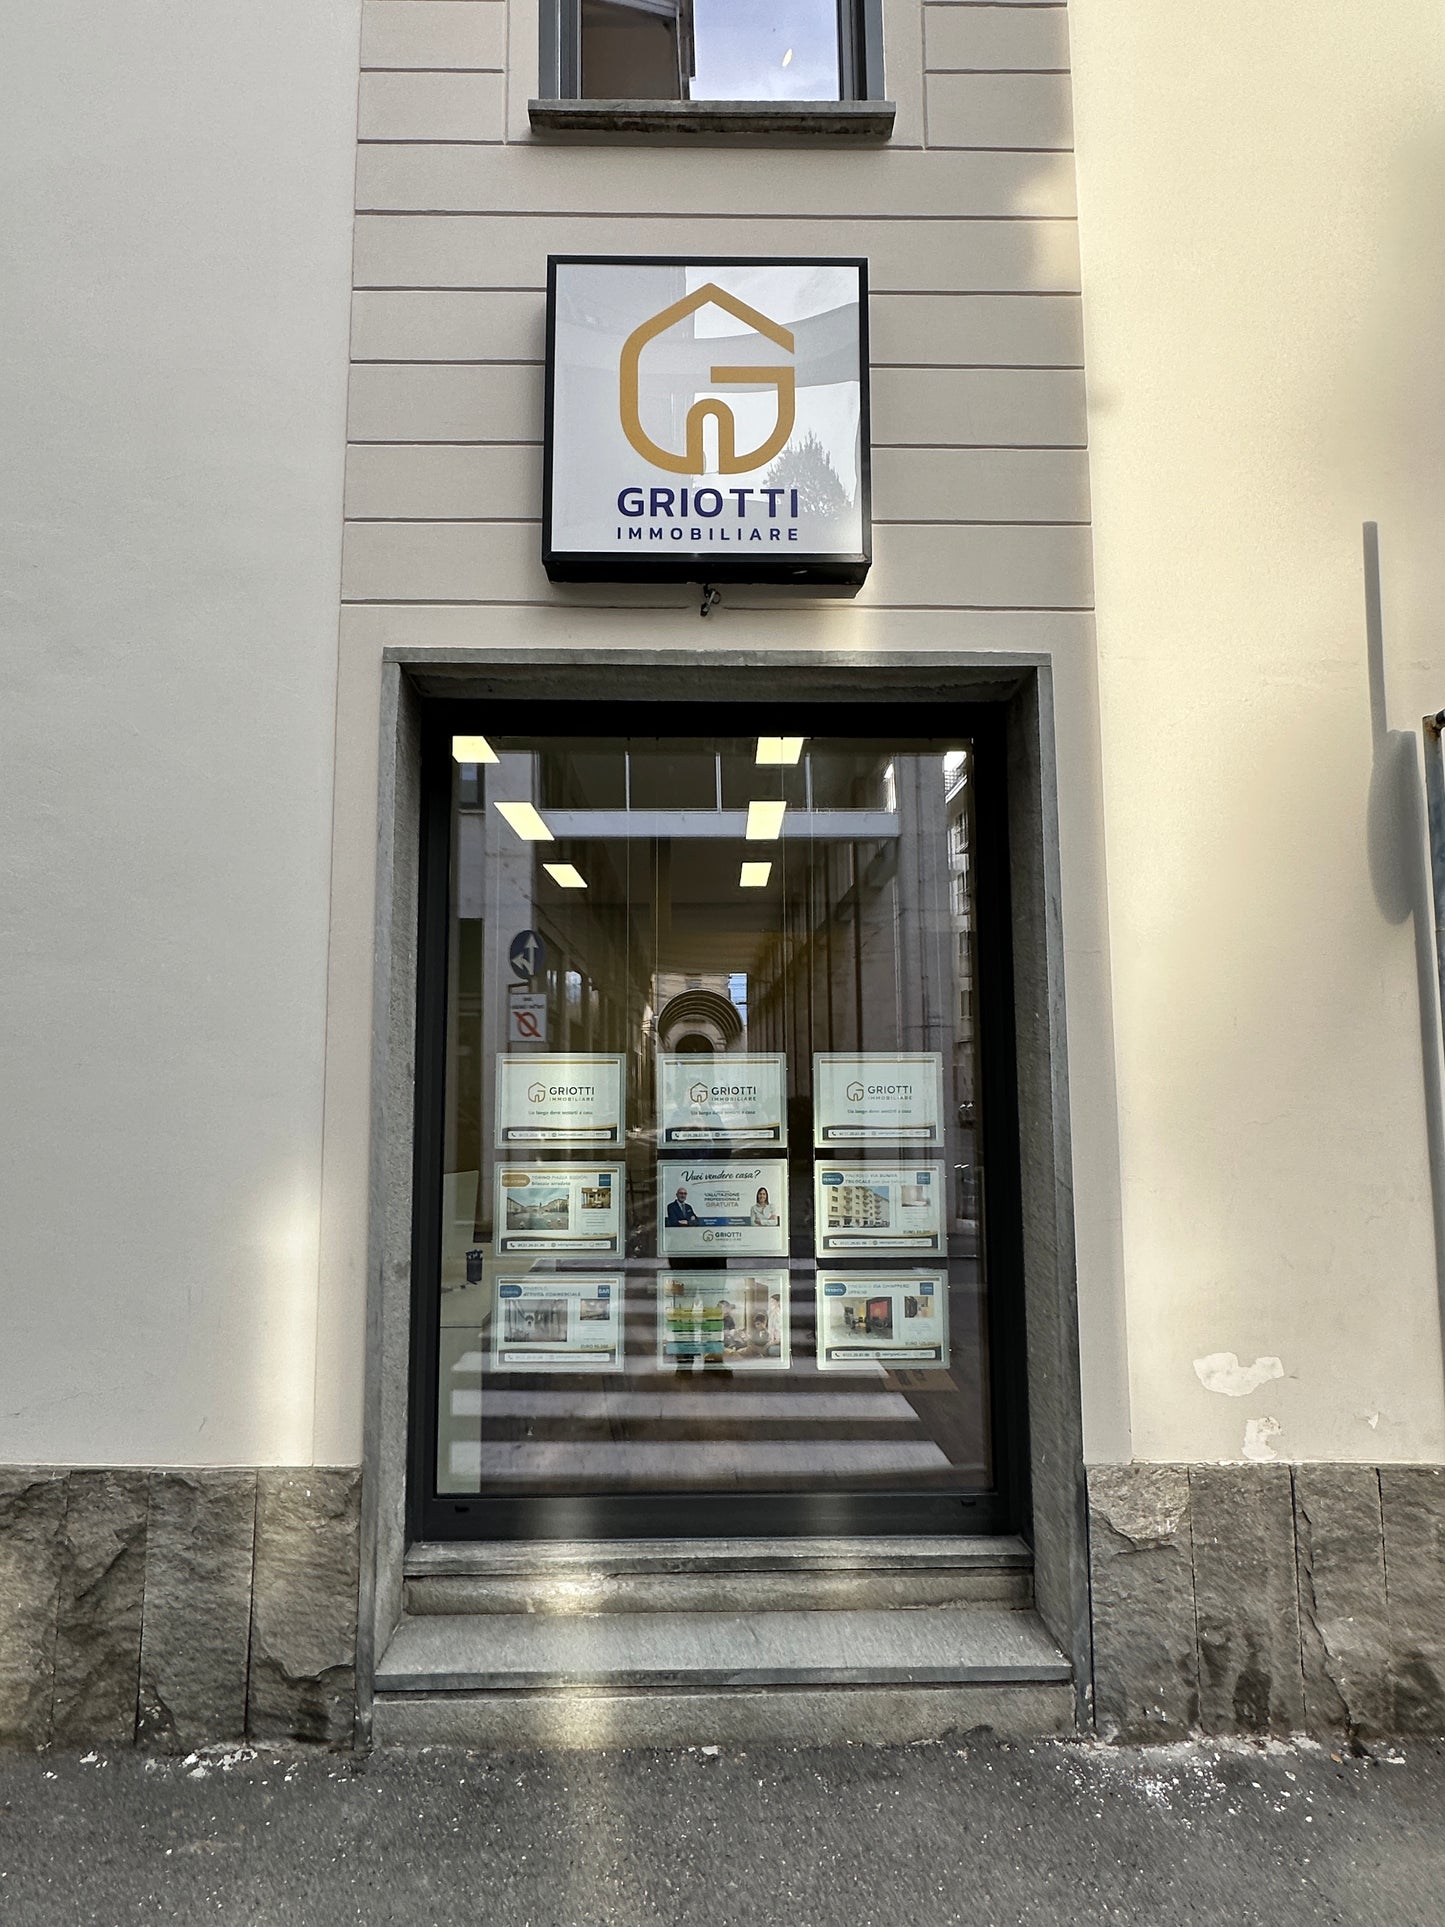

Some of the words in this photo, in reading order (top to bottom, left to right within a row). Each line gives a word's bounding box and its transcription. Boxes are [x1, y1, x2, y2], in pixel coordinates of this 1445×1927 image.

[617, 487, 798, 518] GRIOTTI
[617, 526, 798, 541] IMMOBILIARE
[549, 1086, 595, 1096] GRIOTTI
[711, 1086, 757, 1096] GRIOTTI
[867, 1085, 912, 1094] GRIOTTI
[681, 1170, 703, 1182] Vuoi
[704, 1170, 734, 1181] vendere
[735, 1169, 761, 1179] casa?
